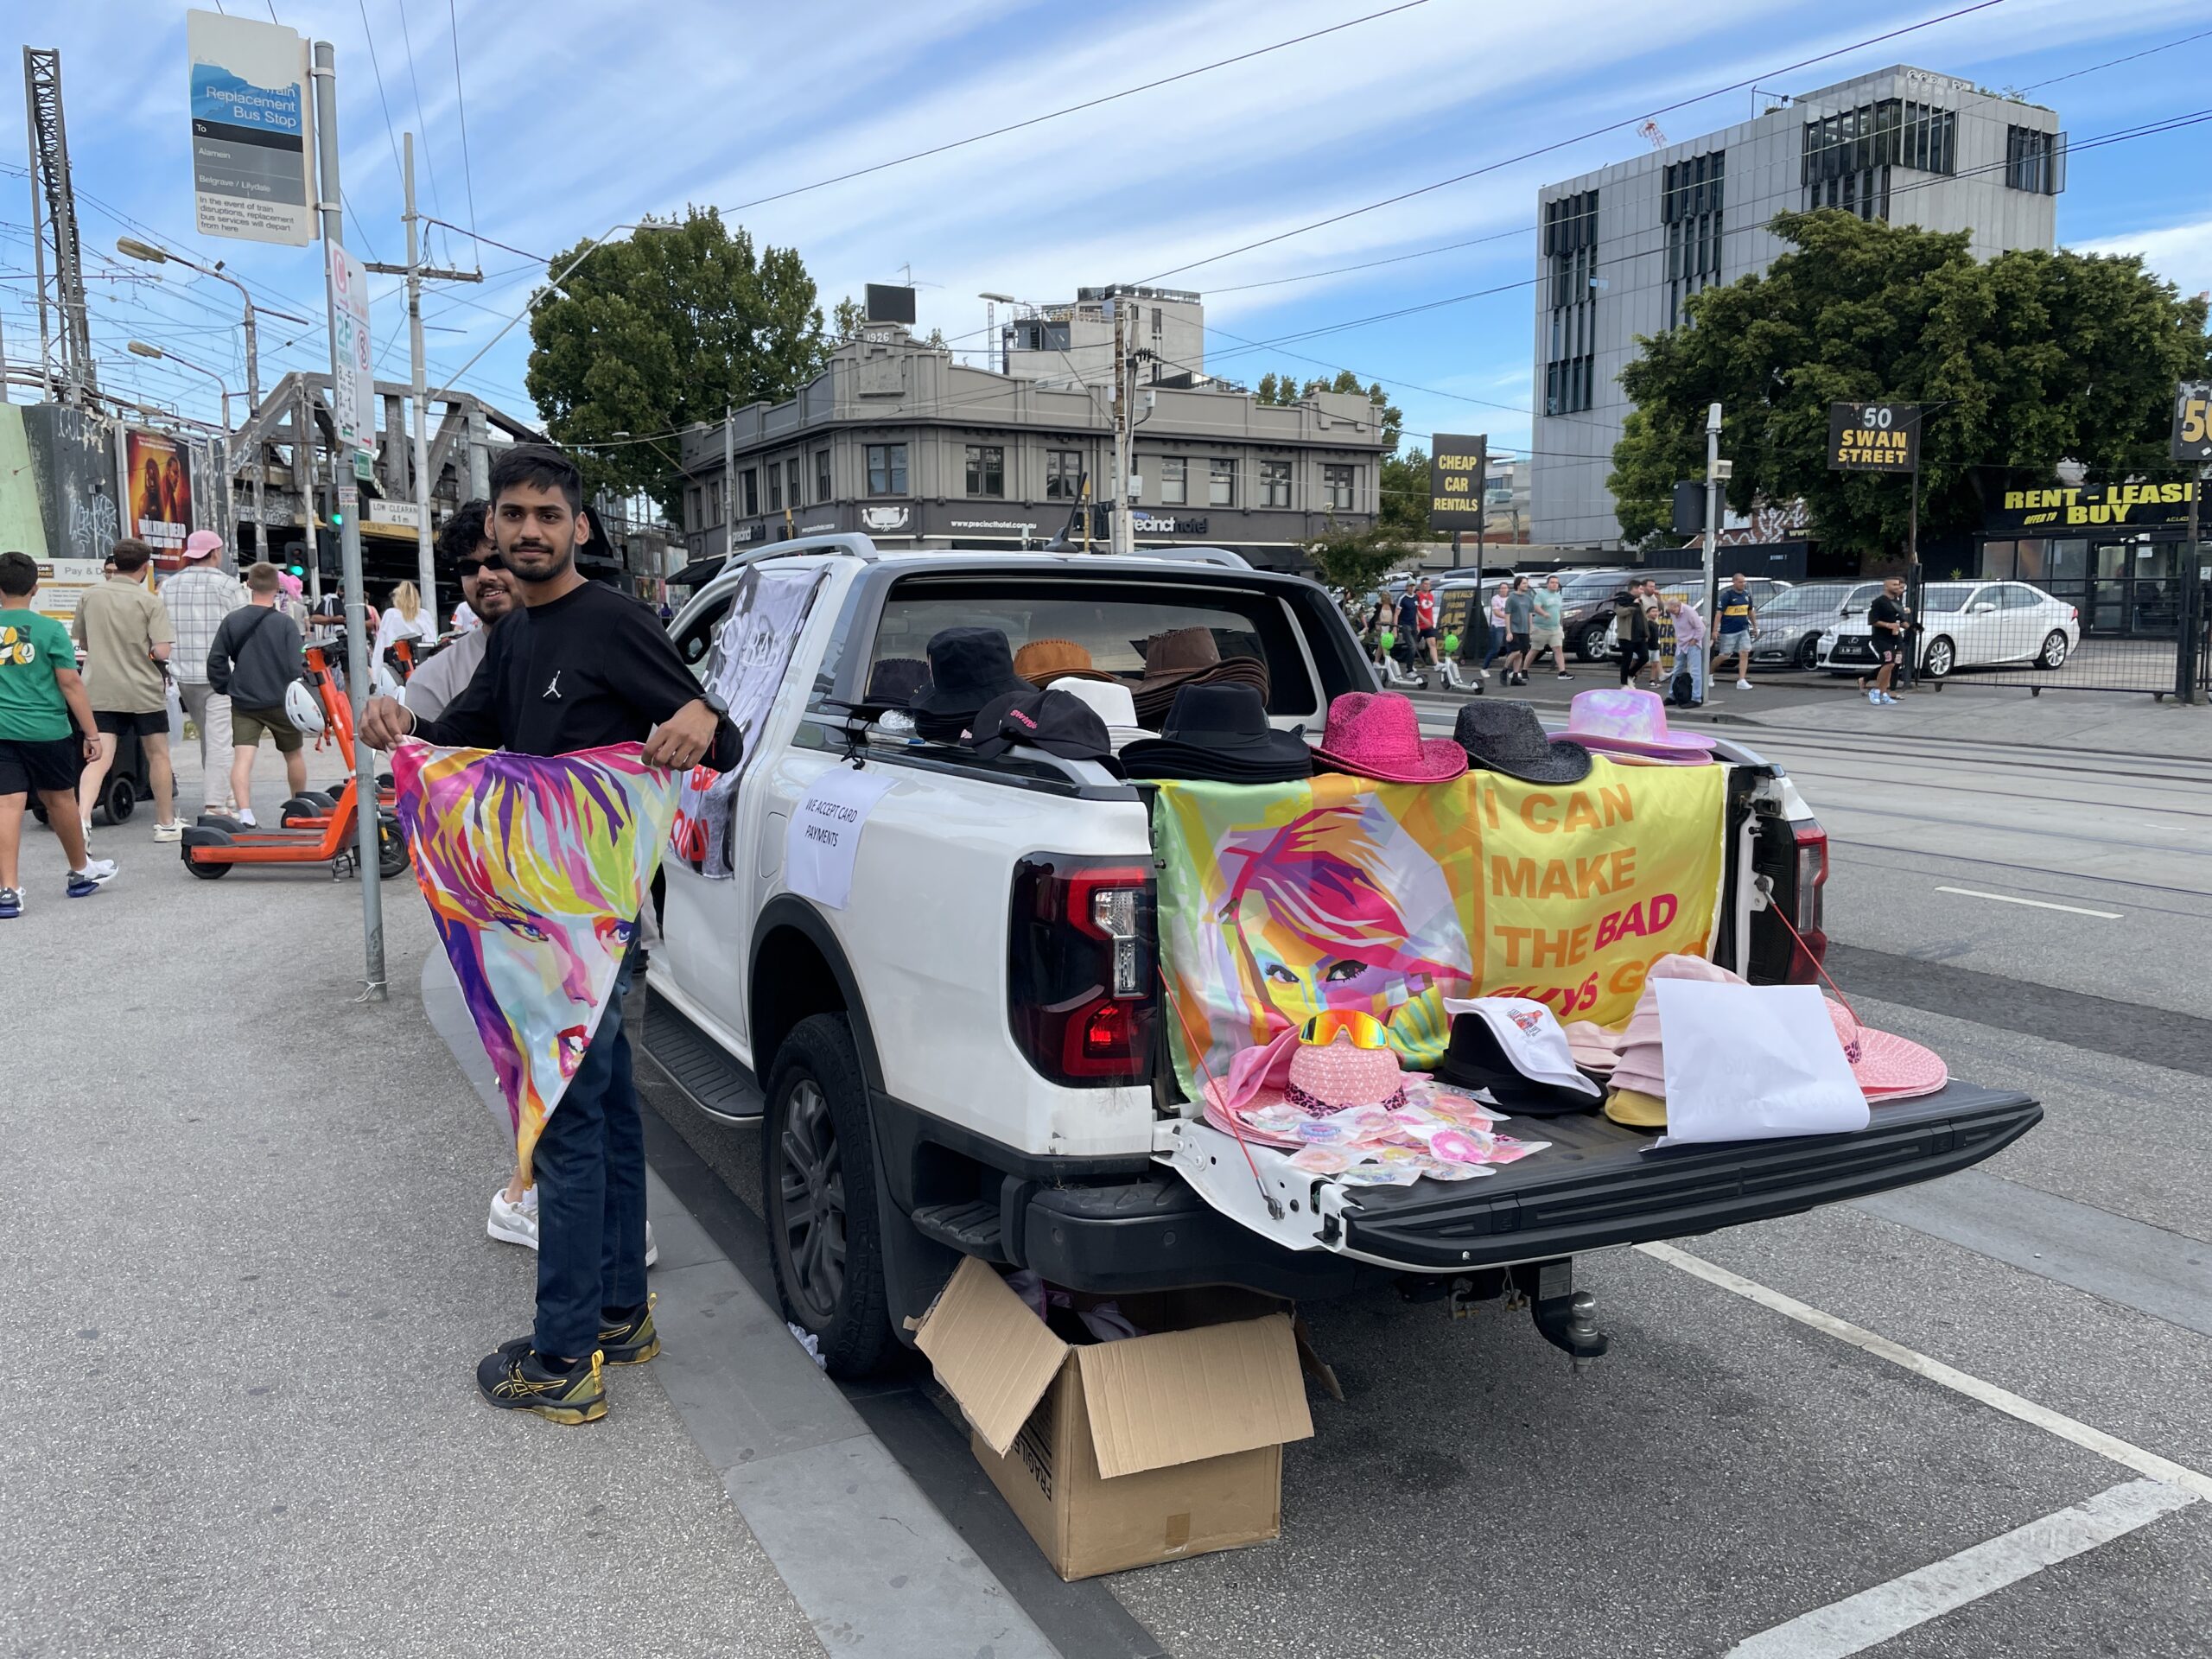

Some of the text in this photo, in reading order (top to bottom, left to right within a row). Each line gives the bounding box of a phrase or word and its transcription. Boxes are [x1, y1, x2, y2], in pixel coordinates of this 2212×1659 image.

[206, 86, 296, 112] Replacement
[233, 105, 296, 129] Bus Stop
[196, 124, 207, 133] To
[199, 147, 231, 159] Alamein
[199, 175, 234, 187] Belgrave
[241, 181, 271, 192] Lilydale
[200, 205, 295, 224] disruptions, replacement
[224, 201, 245, 210] event
[257, 204, 274, 213] train
[200, 213, 291, 232] bus services will depart
[200, 220, 238, 232] from here
[867, 332, 889, 343] 1926
[1864, 407, 1892, 429] 50
[1841, 429, 1907, 448] SWAN
[1438, 454, 1478, 471] CHEAP
[1838, 448, 1907, 464] STREET
[1445, 476, 1469, 492] CAR
[1433, 497, 1478, 512] RENTALS
[2005, 487, 2082, 510] RENT
[2107, 482, 2202, 505] LEASE
[373, 503, 418, 513] LOW CLEARAN
[2024, 504, 2132, 525] OFFER TO BUY
[950, 520, 1037, 529] www.precincthotel.comau
[1133, 516, 1175, 531] ecinct
[64, 567, 82, 576] Pay
[86, 567, 92, 575] &
[805, 798, 858, 823] WE ACCEPT CARD
[1484, 783, 1635, 834] I CAN
[804, 824, 839, 847] PAYMENTS
[1491, 846, 1637, 899] MAKE
[1494, 923, 1592, 969] THE
[1593, 893, 1678, 953] BAD
